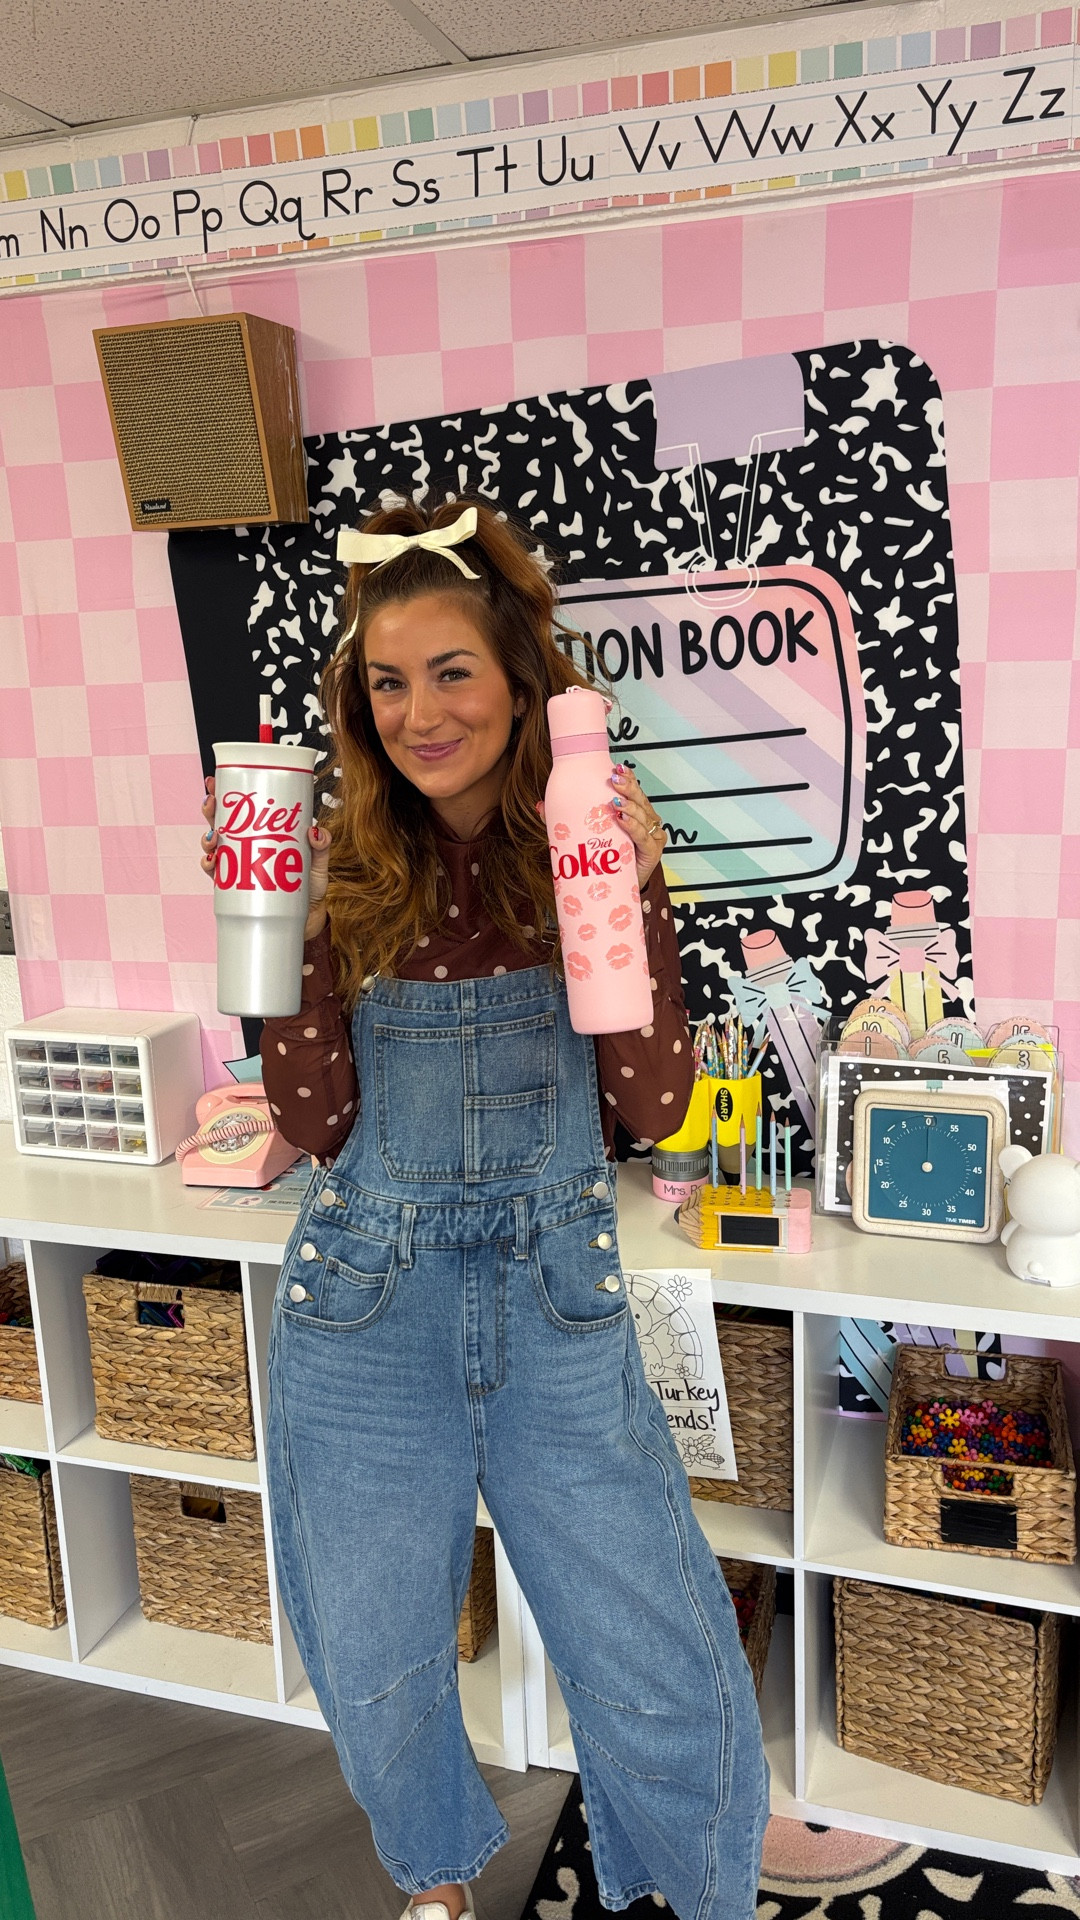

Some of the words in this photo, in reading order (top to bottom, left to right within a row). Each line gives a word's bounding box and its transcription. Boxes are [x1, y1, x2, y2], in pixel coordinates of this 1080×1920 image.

[40, 207, 89, 253] Nn
[104, 199, 161, 243] Oo
[173, 189, 223, 254] Pp
[239, 180, 317, 241] Qq
[322, 168, 373, 218] Rr
[393, 160, 440, 207] Ss
[456, 144, 518, 198] Tt
[537, 135, 594, 186] Uu
[618, 120, 681, 173] Vv
[694, 104, 814, 163] Ww
[834, 90, 895, 147] Xx
[916, 79, 978, 156] Yy
[1001, 66, 1066, 125] Zz
[679, 607, 819, 675] BOOK
[217, 791, 303, 835] Diet
[587, 838, 613, 850] Diet
[213, 836, 304, 893] oke
[865, 1036, 871, 1057] 1
[938, 1050, 950, 1064] 5
[1017, 1050, 1030, 1070] 3
[720, 1089, 729, 1122] SHARP
[901, 1121, 907, 1129] 5
[925, 1117, 932, 1126] 0
[950, 1124, 960, 1133] 55
[882, 1136, 891, 1145] 10
[967, 1143, 977, 1152] 50
[876, 1158, 884, 1167] 15
[972, 1166, 983, 1175] 45
[880, 1180, 890, 1189] 20
[663, 1184, 688, 1196] Mrs.
[964, 1188, 975, 1197] 40
[898, 1199, 908, 1208] 25
[921, 1208, 932, 1217] 30
[946, 1205, 956, 1213] 35
[650, 1379, 719, 1412] Turkey
